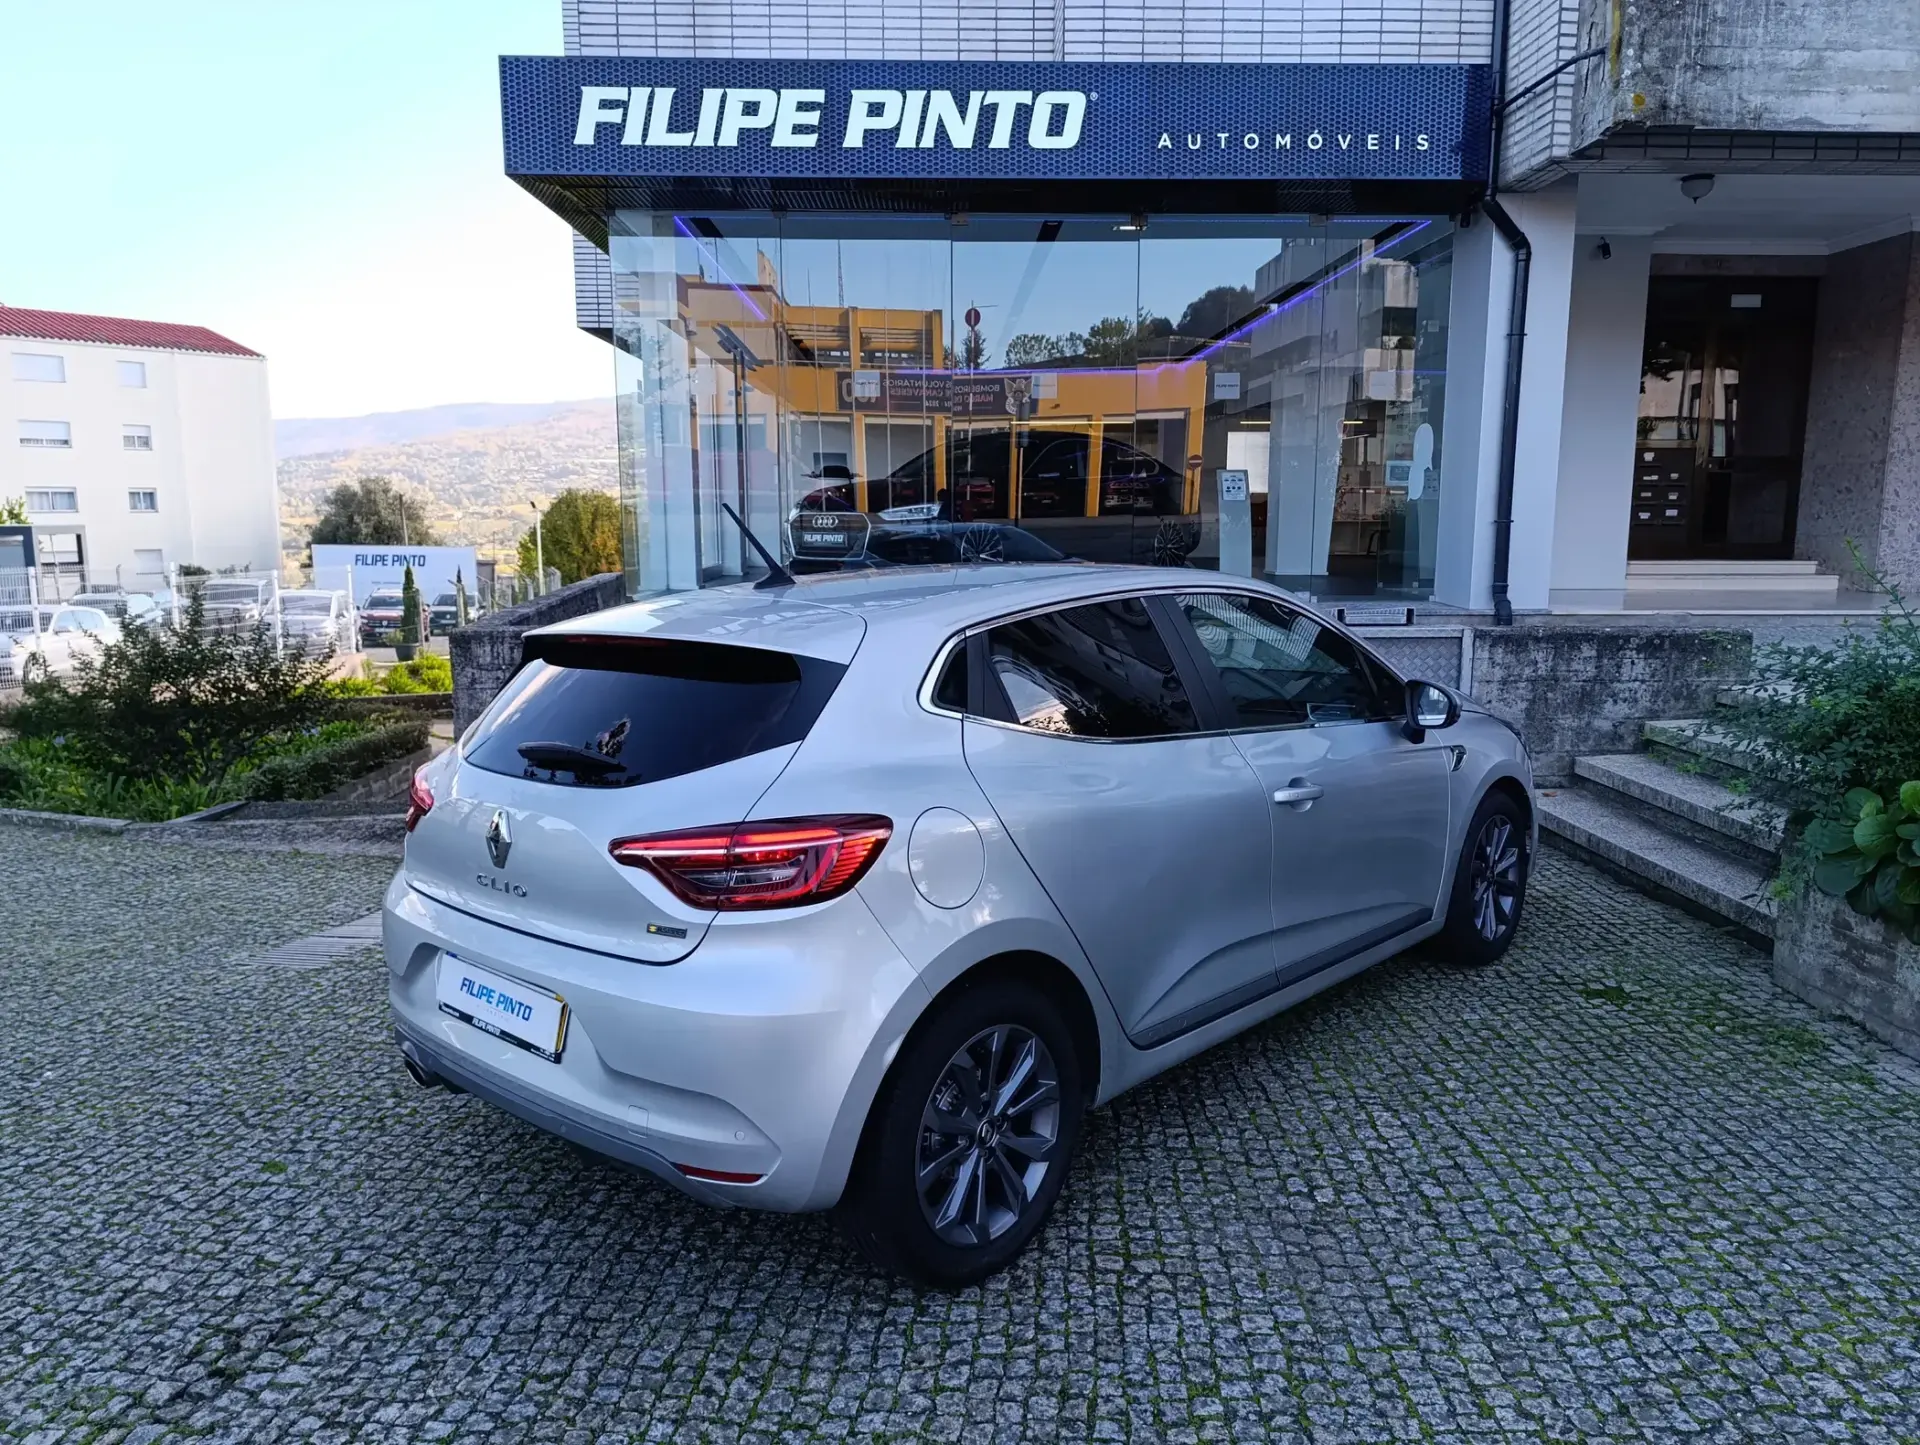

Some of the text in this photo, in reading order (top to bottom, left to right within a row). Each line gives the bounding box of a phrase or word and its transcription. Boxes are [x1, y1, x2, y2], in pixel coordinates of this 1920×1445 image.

[573, 86, 1087, 149] FILIPE PINTO
[1157, 130, 1429, 151] AUTOMÓVEIS
[355, 554, 426, 567] FILIPE PINTO
[476, 873, 527, 898] CLIO
[459, 977, 496, 1005] FILIPE
[496, 992, 533, 1021] PINTO
